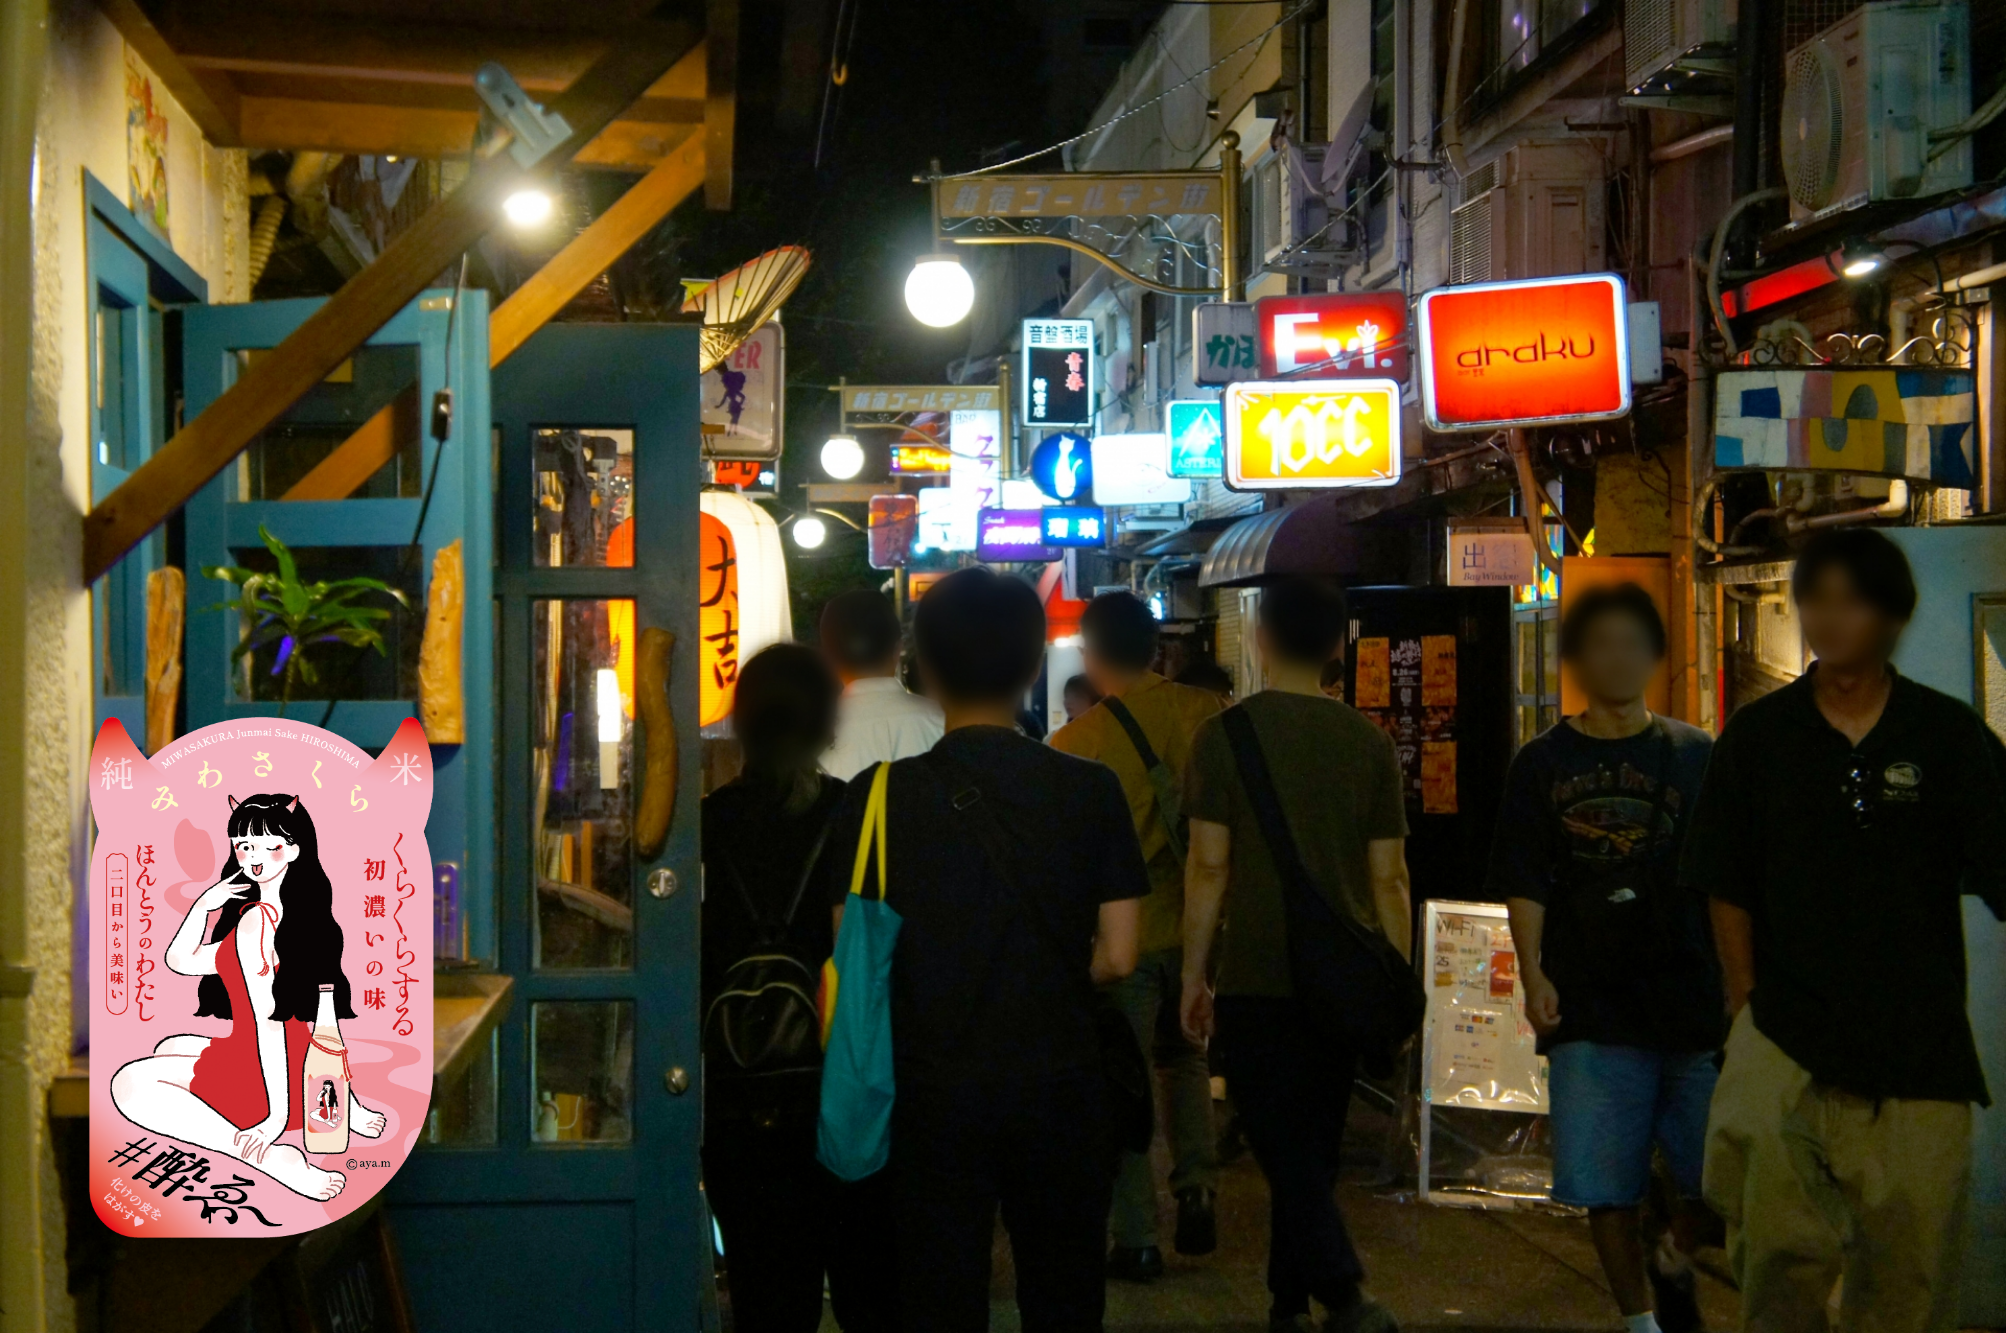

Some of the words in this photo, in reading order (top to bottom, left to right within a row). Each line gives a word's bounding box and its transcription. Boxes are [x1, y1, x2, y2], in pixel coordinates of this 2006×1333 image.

[953, 184, 1209, 213] 新宿ゴールデン街
[1029, 325, 1087, 344] 音盤酒場
[1457, 330, 1595, 368] araku
[853, 392, 992, 409] 新宿ゴールデン街
[1464, 572, 1480, 582] Bay
[1482, 572, 1518, 580] Window
